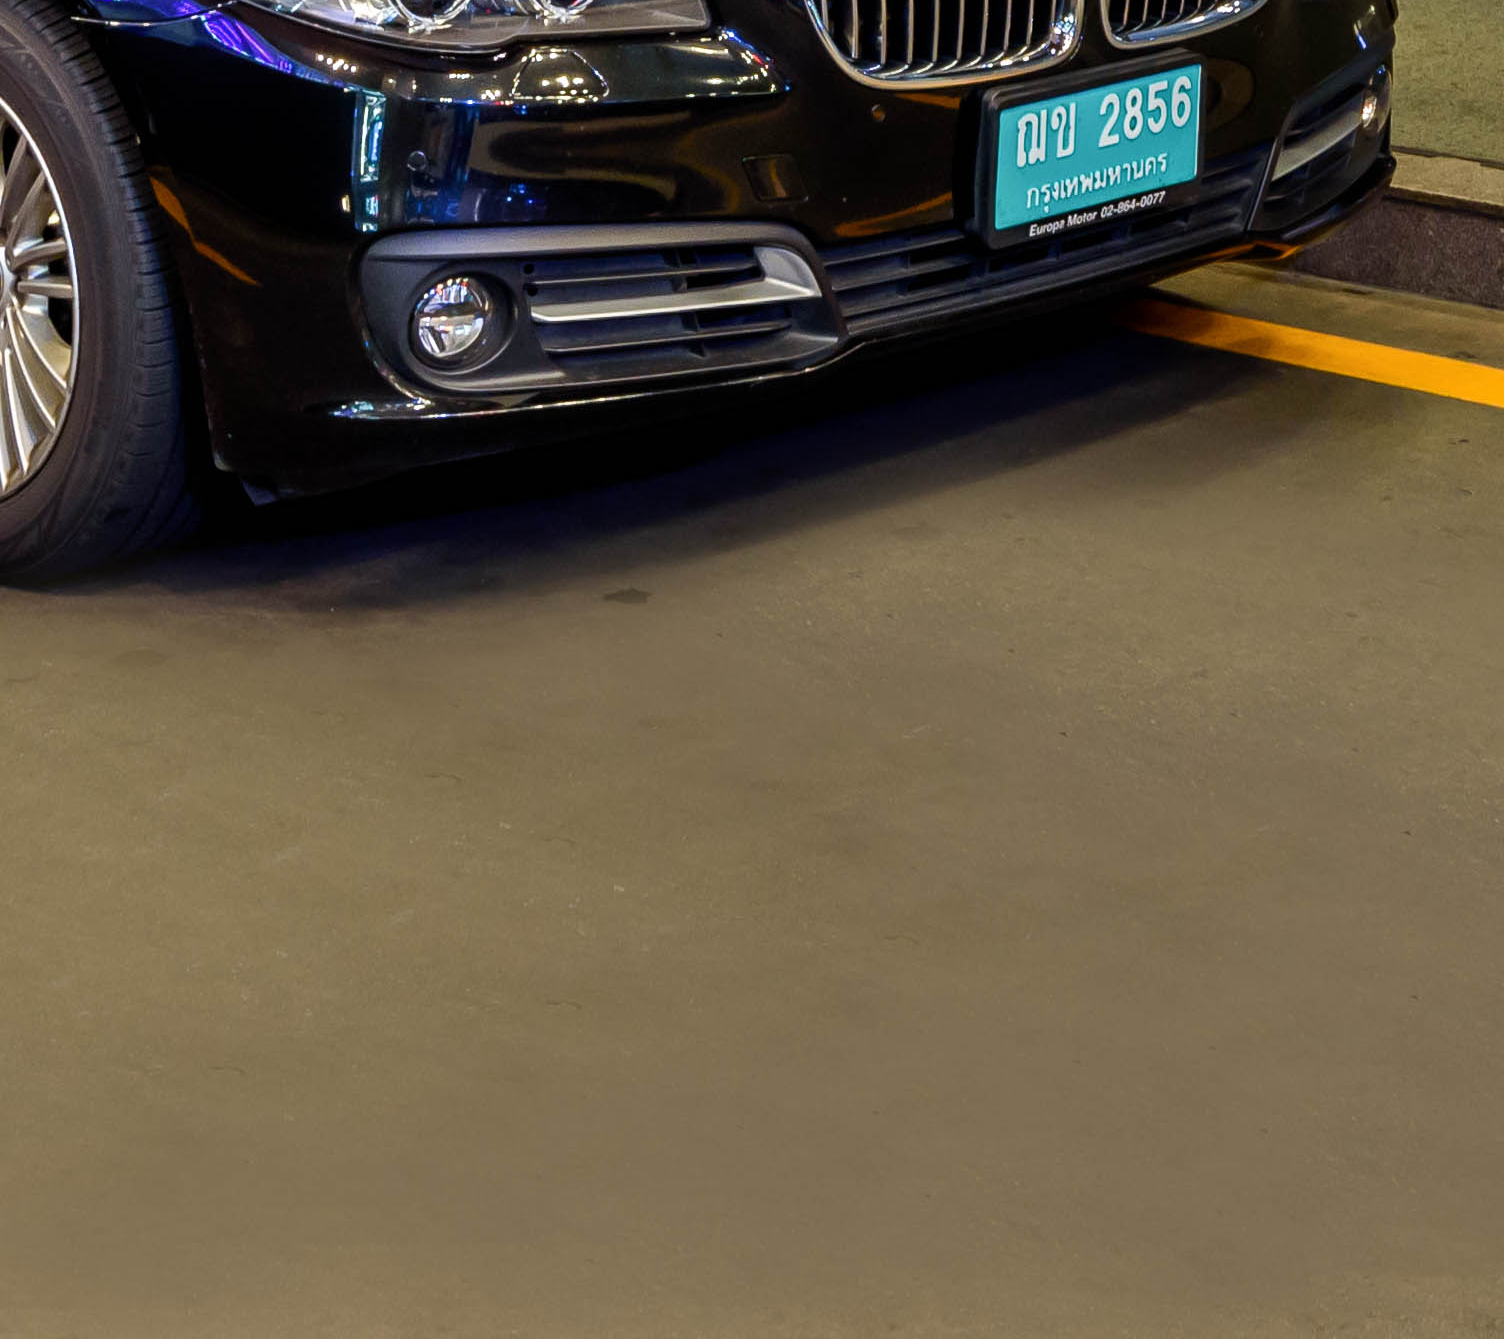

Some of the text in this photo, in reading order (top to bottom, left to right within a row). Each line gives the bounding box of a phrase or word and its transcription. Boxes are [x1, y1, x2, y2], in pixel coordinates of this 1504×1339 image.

[1098, 75, 1192, 148] 2856
[1025, 152, 1168, 214] กรุงเทพมหานคร
[1028, 189, 1167, 238] Europa Motor 02-864-0077
